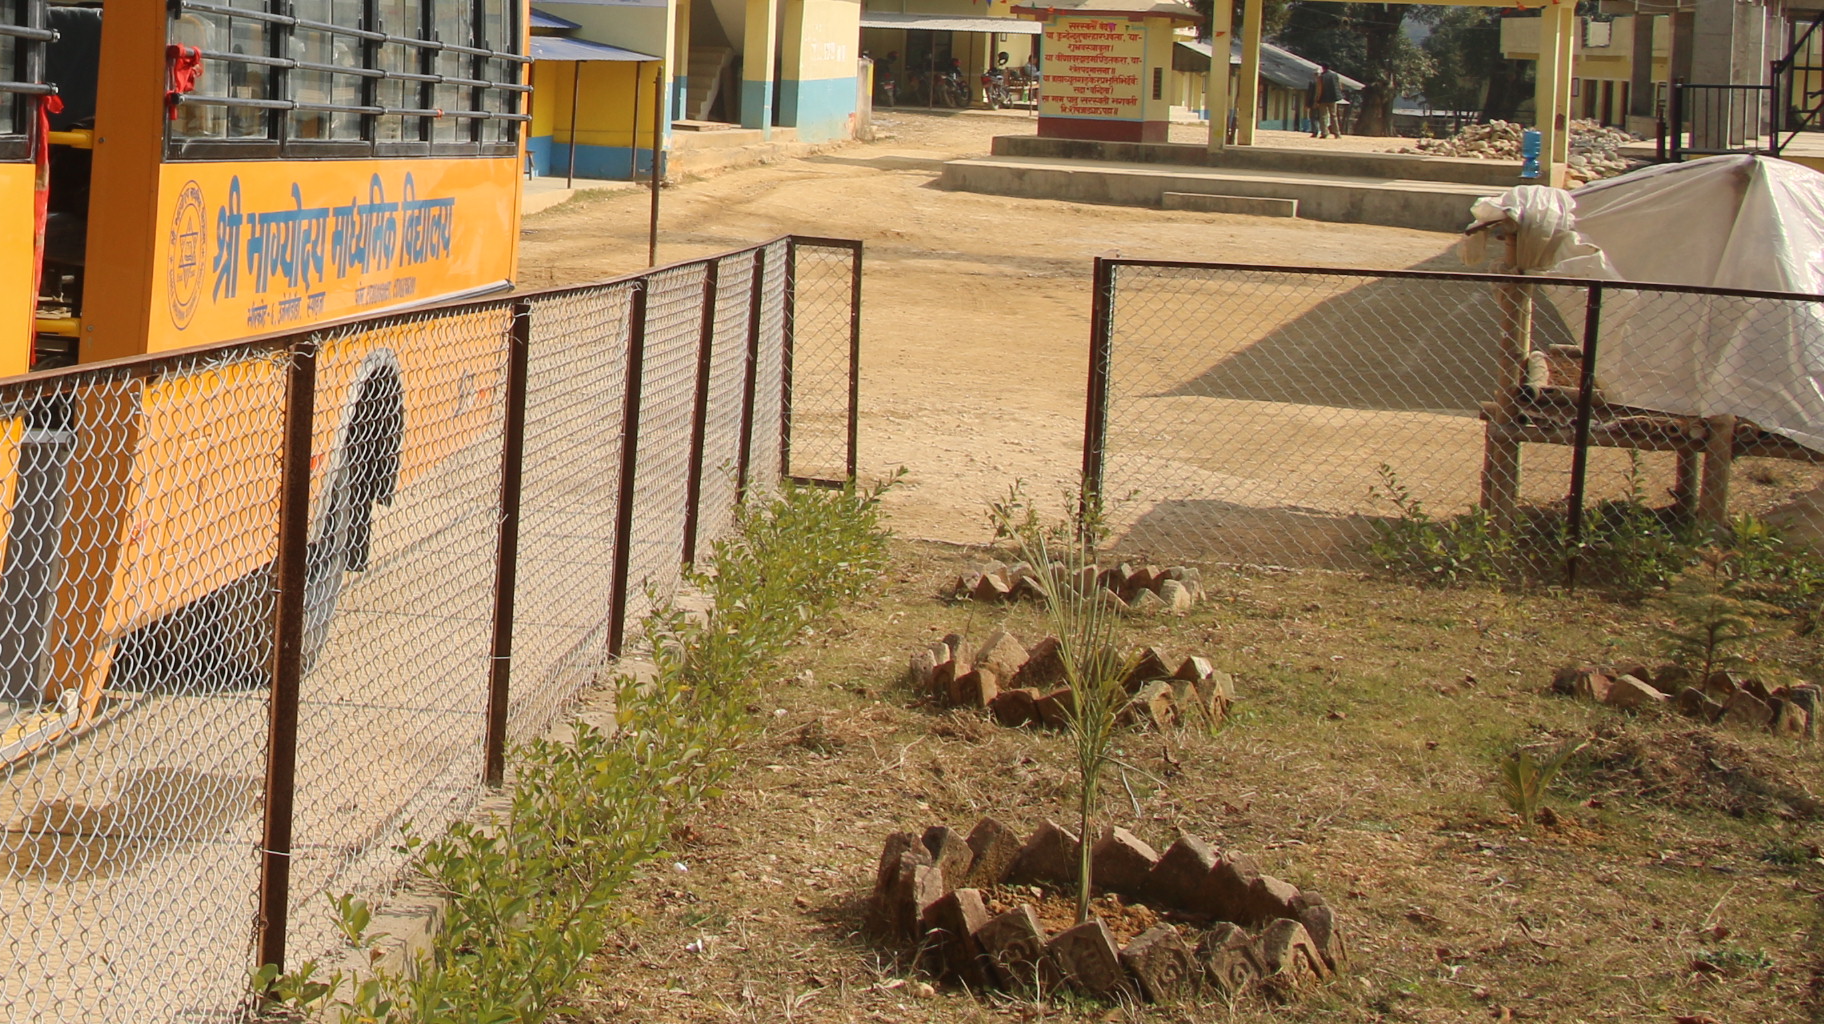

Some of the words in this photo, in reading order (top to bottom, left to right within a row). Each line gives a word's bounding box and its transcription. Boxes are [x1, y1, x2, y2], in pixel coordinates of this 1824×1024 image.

[212, 175, 244, 305] श्री
[246, 182, 330, 293] भाग्योदय
[332, 173, 399, 279] माध्यमिक
[400, 172, 456, 268] विद्यालय
